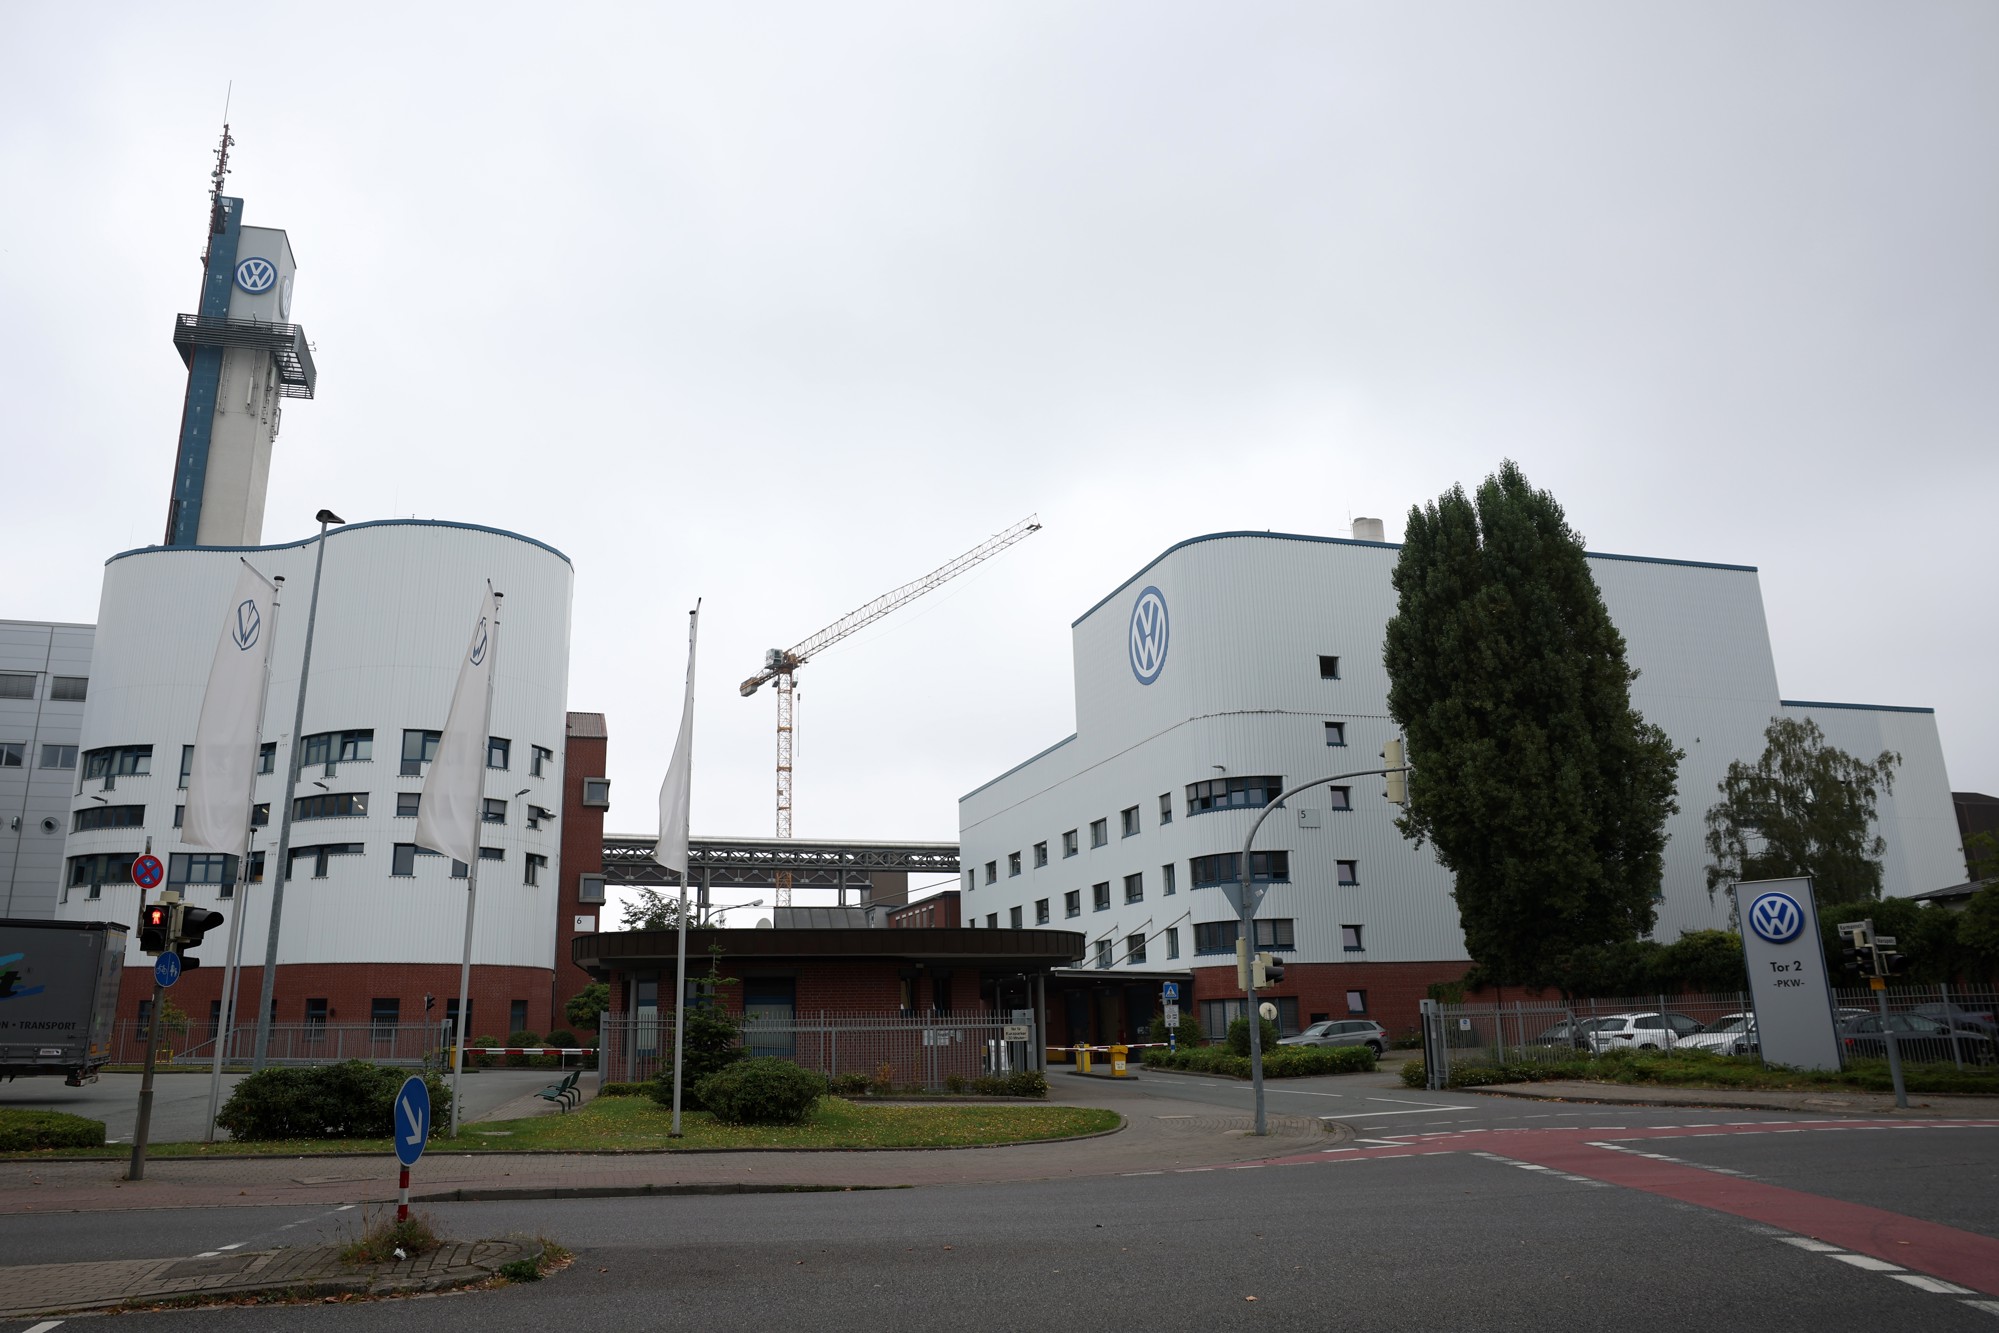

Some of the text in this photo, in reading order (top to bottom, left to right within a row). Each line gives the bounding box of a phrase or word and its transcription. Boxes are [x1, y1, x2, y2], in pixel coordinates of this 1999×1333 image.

[1131, 591, 1167, 679] VW
[1300, 809, 1307, 819] 5
[576, 916, 582, 925] 6
[1752, 895, 1800, 940] VW
[1770, 960, 1803, 972] Tor 2
[1773, 979, 1805, 987] -PKW-
[19, 1021, 77, 1030] TRANSPORT
